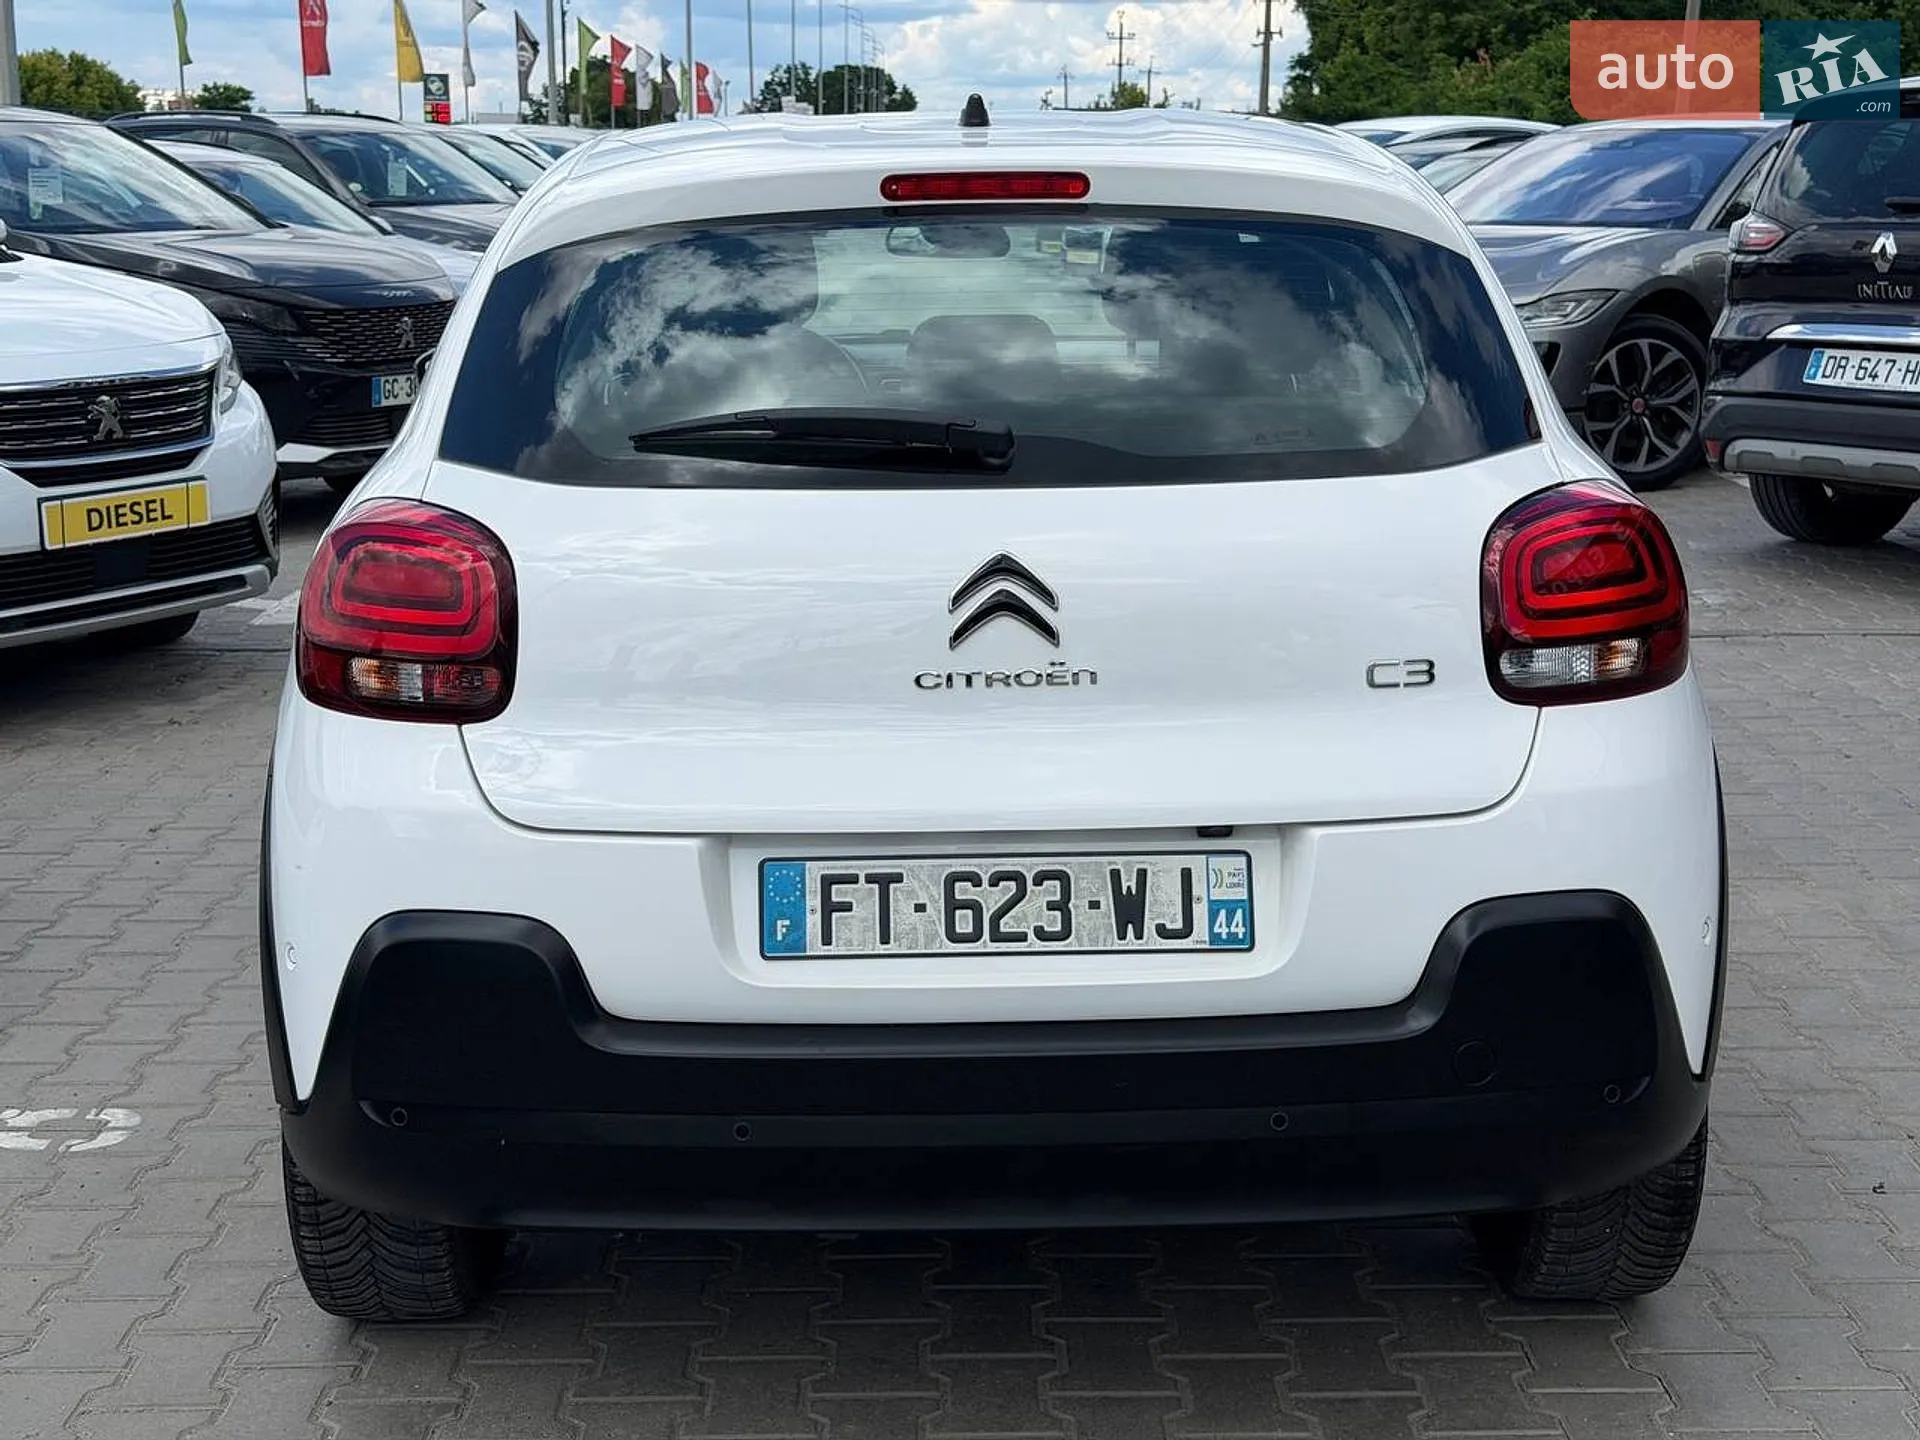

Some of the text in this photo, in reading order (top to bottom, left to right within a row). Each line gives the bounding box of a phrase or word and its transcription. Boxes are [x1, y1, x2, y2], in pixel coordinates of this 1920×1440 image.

[86, 498, 174, 532] DIESEL
[1366, 659, 1435, 688] C3
[777, 919, 790, 941] F
[1213, 908, 1246, 939] 44
